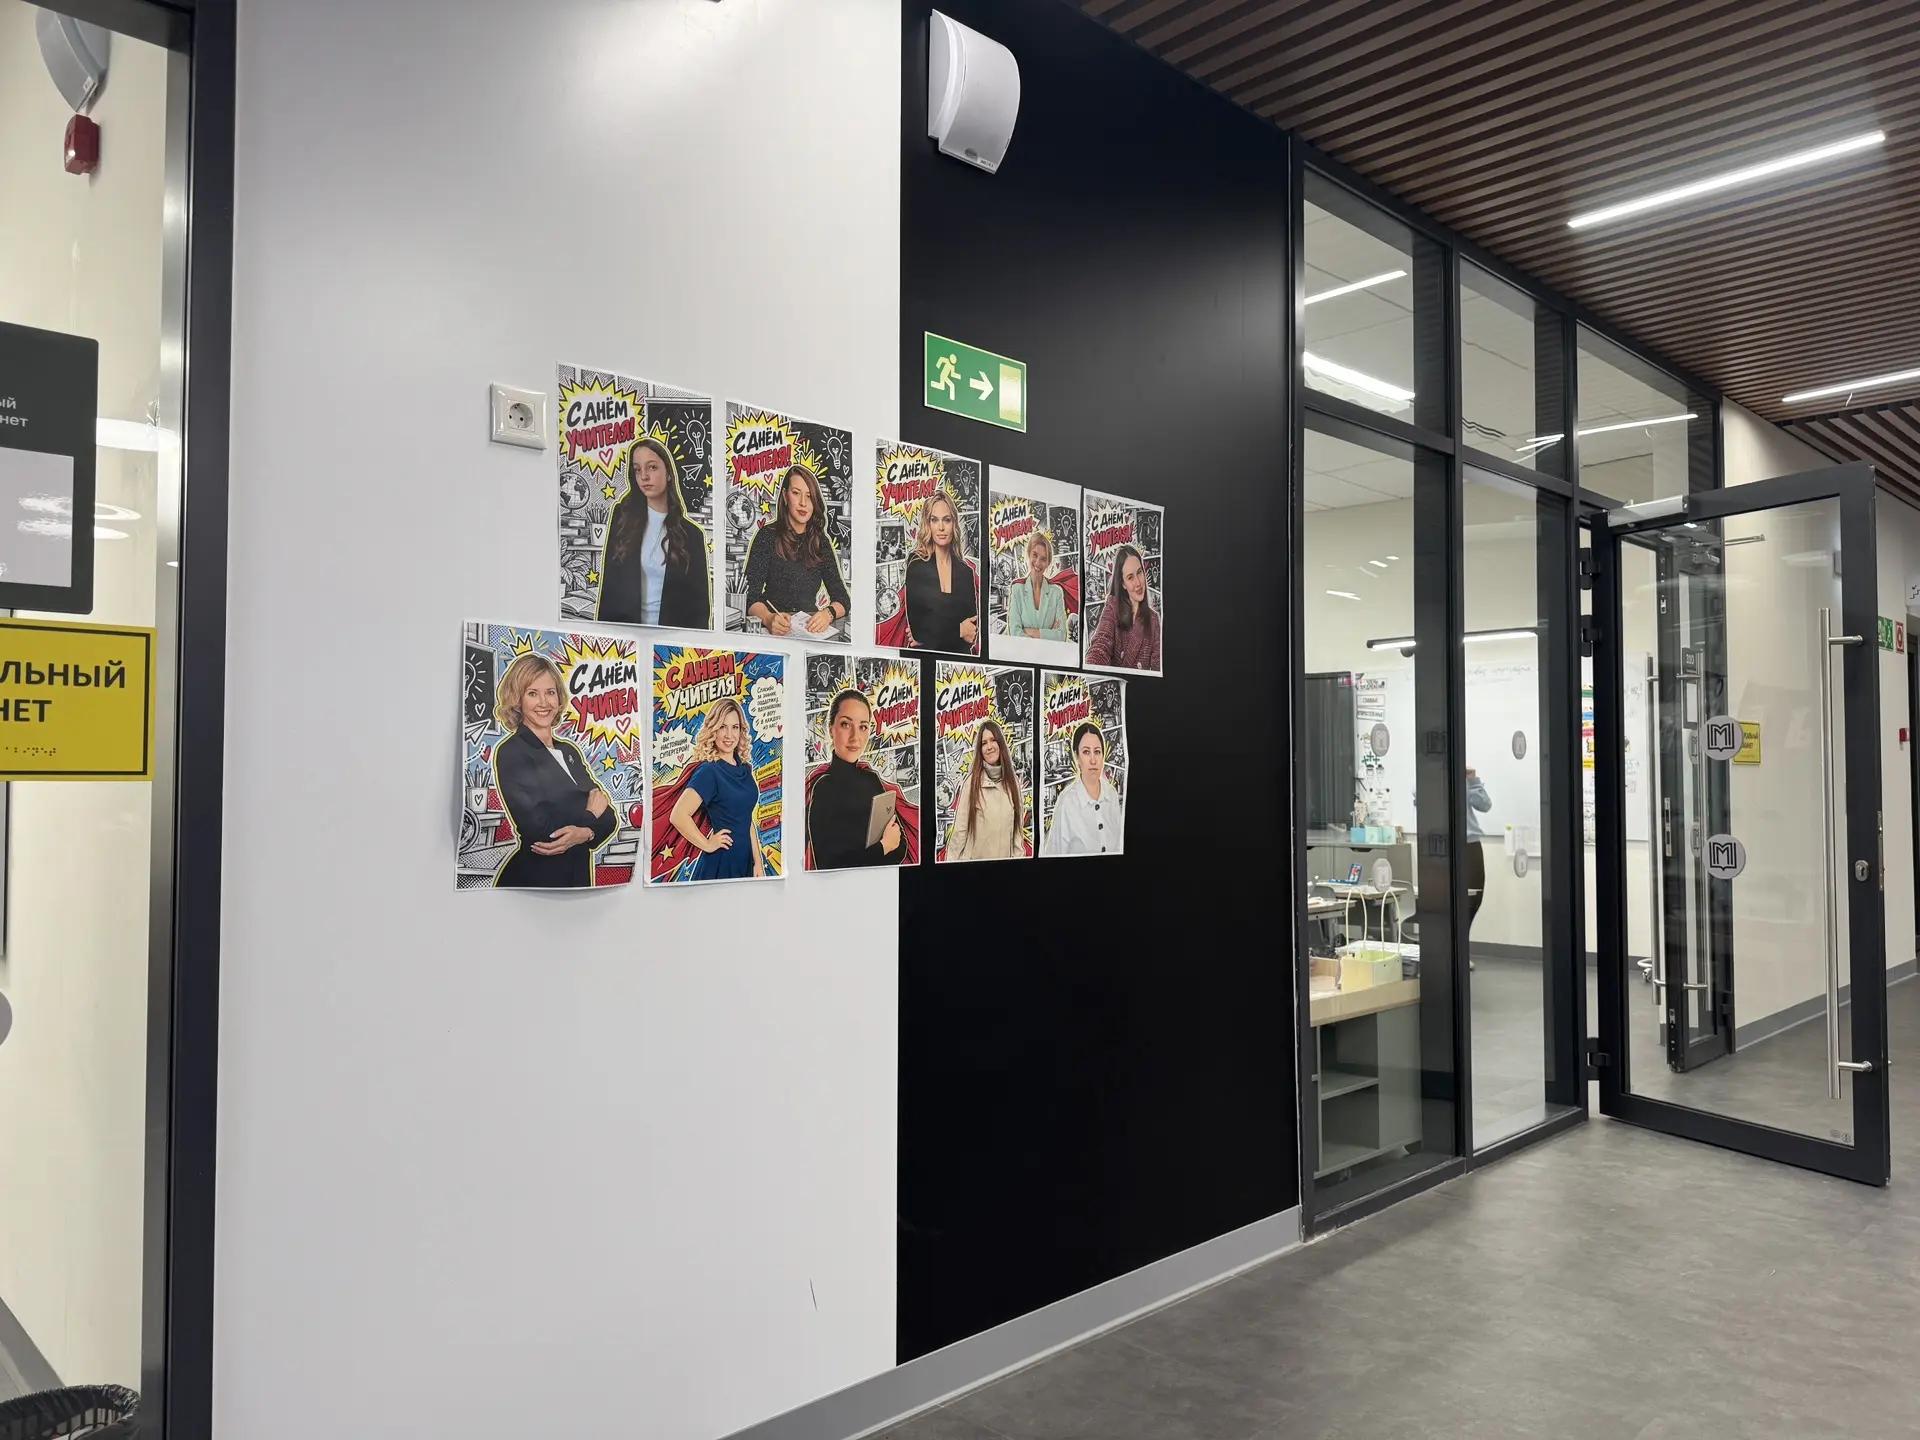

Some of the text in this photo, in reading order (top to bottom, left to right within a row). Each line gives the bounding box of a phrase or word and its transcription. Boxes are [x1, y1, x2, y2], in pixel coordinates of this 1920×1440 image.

[567, 397, 628, 427] С ДНЁМ
[566, 417, 635, 460] УЧИТЕЛЯ!
[733, 427, 783, 454] С ДНЁМ
[731, 444, 792, 486] УЧИТЕЛЯ!
[887, 460, 929, 482] С ДНЁМ
[881, 477, 938, 512] УЧИТЕЛЯ!
[994, 504, 1026, 525] С ДНЁМ
[1091, 511, 1124, 531] С ДНЁМ
[1089, 521, 1135, 555] УЧИТЕЛЯ!
[569, 661, 637, 695] С ДНЁМ
[666, 666, 681, 690] С
[877, 683, 913, 707] С ДНЁМ
[571, 687, 638, 733] УЧИТЕЛ
[666, 673, 743, 720] УЧИТЕЛЯ!
[937, 681, 982, 710] С ДНЁМ
[1049, 686, 1081, 709] С ДНЁМ
[873, 695, 919, 736] УЧИТЕЛЯ!
[936, 695, 989, 738] УЧИТЕЛЯ!
[1047, 699, 1091, 736] УЧИТЕЛЯ!
